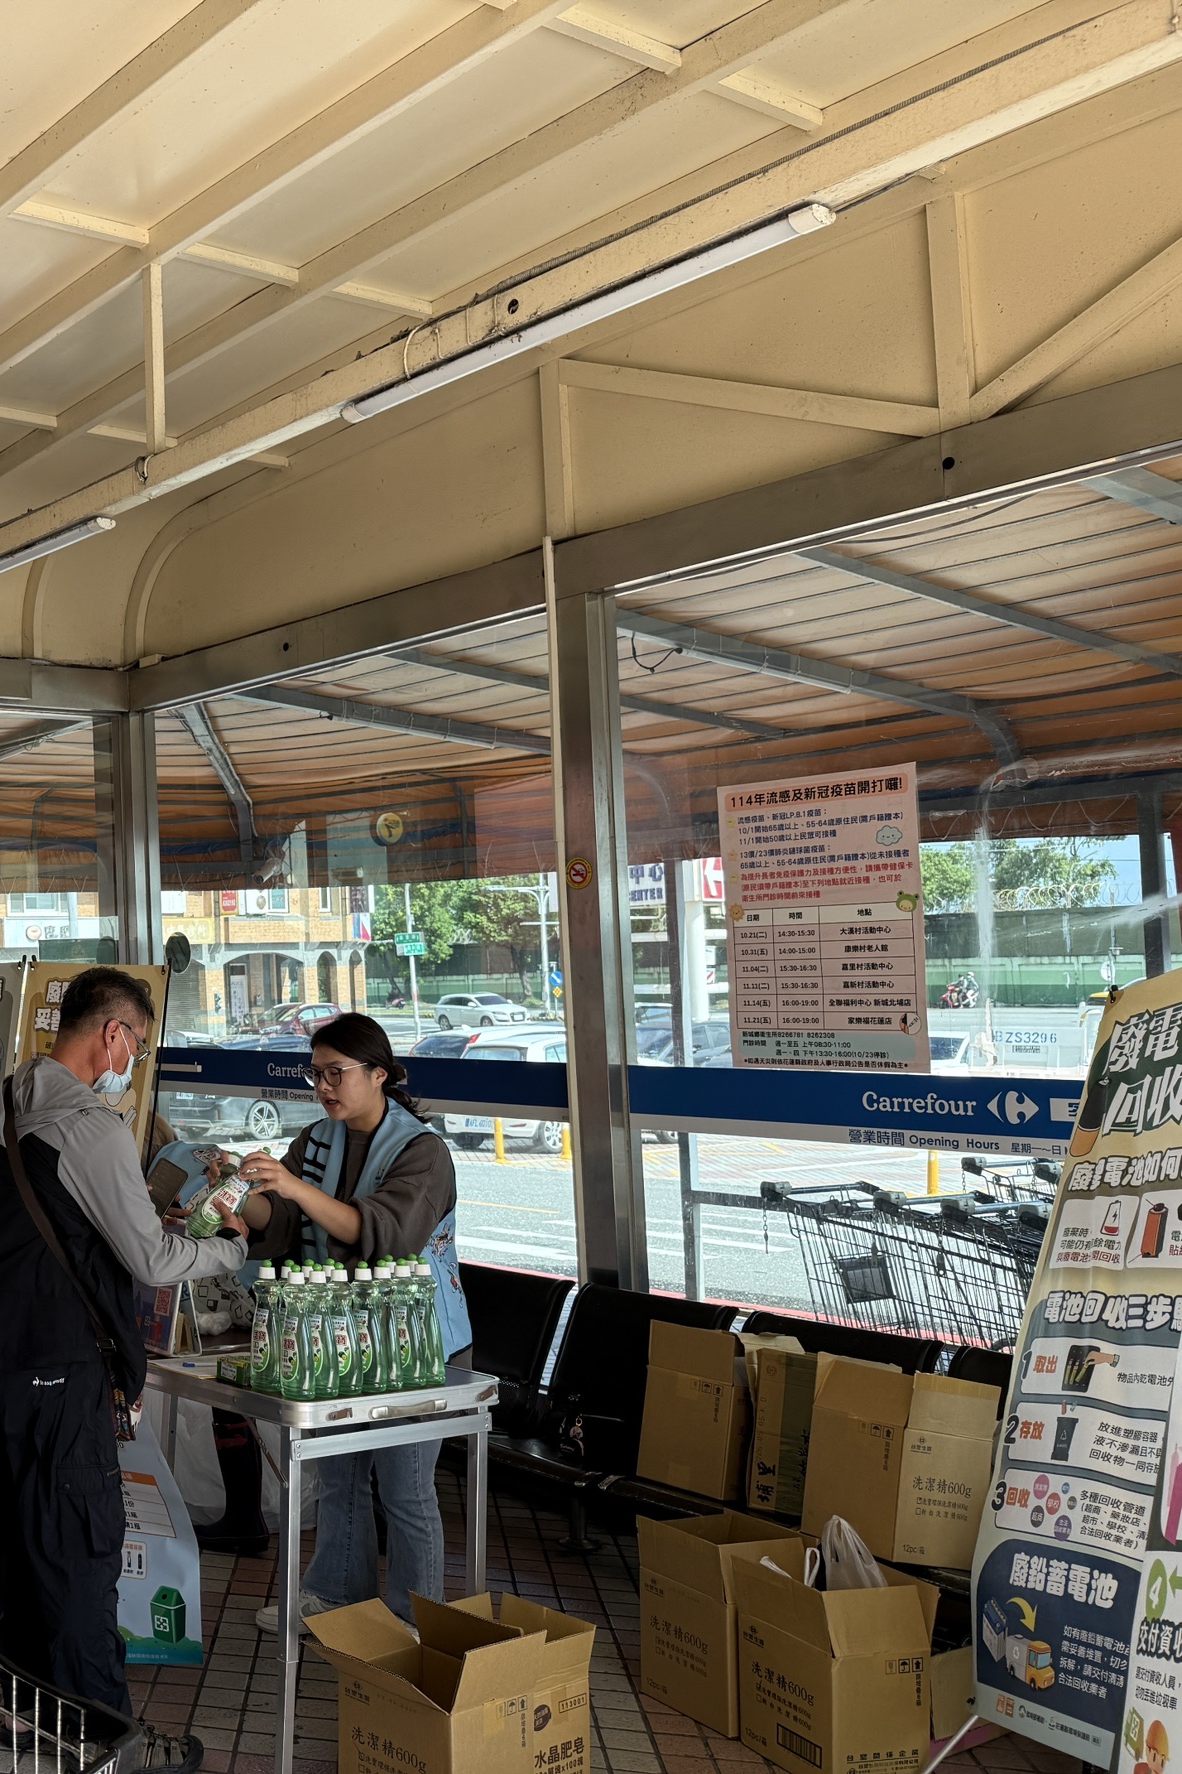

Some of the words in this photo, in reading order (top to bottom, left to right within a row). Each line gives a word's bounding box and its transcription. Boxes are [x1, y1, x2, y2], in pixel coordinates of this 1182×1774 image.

[730, 777, 903, 808] 114年流感及新冠疫苗開打囉!
[629, 888, 663, 901] ENTER
[746, 914, 760, 922] 日期
[789, 912, 803, 920] 時間
[857, 908, 872, 917] 地點
[740, 931, 767, 939] 10.21(二)
[777, 929, 815, 937] 14:30-15:30
[741, 948, 768, 956] 10.31(五)
[778, 946, 816, 955] 14:00-15:00
[742, 965, 768, 973] 11.04(二)
[779, 964, 817, 972] 15:30-16:30
[743, 982, 770, 990] 11.11(二)
[781, 981, 818, 989] 15:30-16:30
[743, 999, 771, 1007] 11.14(五)
[782, 999, 819, 1007] 16:00-19:00
[828, 998, 872, 1007] 全聯福利中心
[743, 1016, 771, 1025] 11.21(五)
[782, 1016, 819, 1024] 16:00-19:00
[261, 1088, 288, 1100] 營業時間
[289, 1091, 314, 1102] Opening
[862, 1091, 977, 1116] Carrefour
[848, 1128, 905, 1146] 營業時間
[909, 1134, 960, 1149] Opening
[966, 1138, 1000, 1151] Hours
[1021, 1350, 1033, 1380] 1
[1033, 1355, 1058, 1374] 取出
[1004, 1414, 1019, 1444] 2
[1019, 1420, 1045, 1440] 存放
[912, 1476, 972, 1498] 洗潔精600g
[991, 1481, 1007, 1511] 3
[1006, 1486, 1031, 1508] 回收
[1080, 1490, 1146, 1516] 多種回收管道
[1082, 1514, 1149, 1539] 超市、學校、清
[1080, 1526, 1138, 1549] 合法回收業者)
[1009, 1552, 1118, 1609] 廢鉛蓄電池
[1149, 1576, 1163, 1609] 4
[650, 1615, 709, 1655] 洗潔精600g
[751, 1660, 815, 1707] 洗潔精600g
[1059, 1672, 1108, 1699] 合法回收業者
[352, 1726, 426, 1774] 洗潔精600g
[534, 1736, 584, 1769] 水晶肥皂
